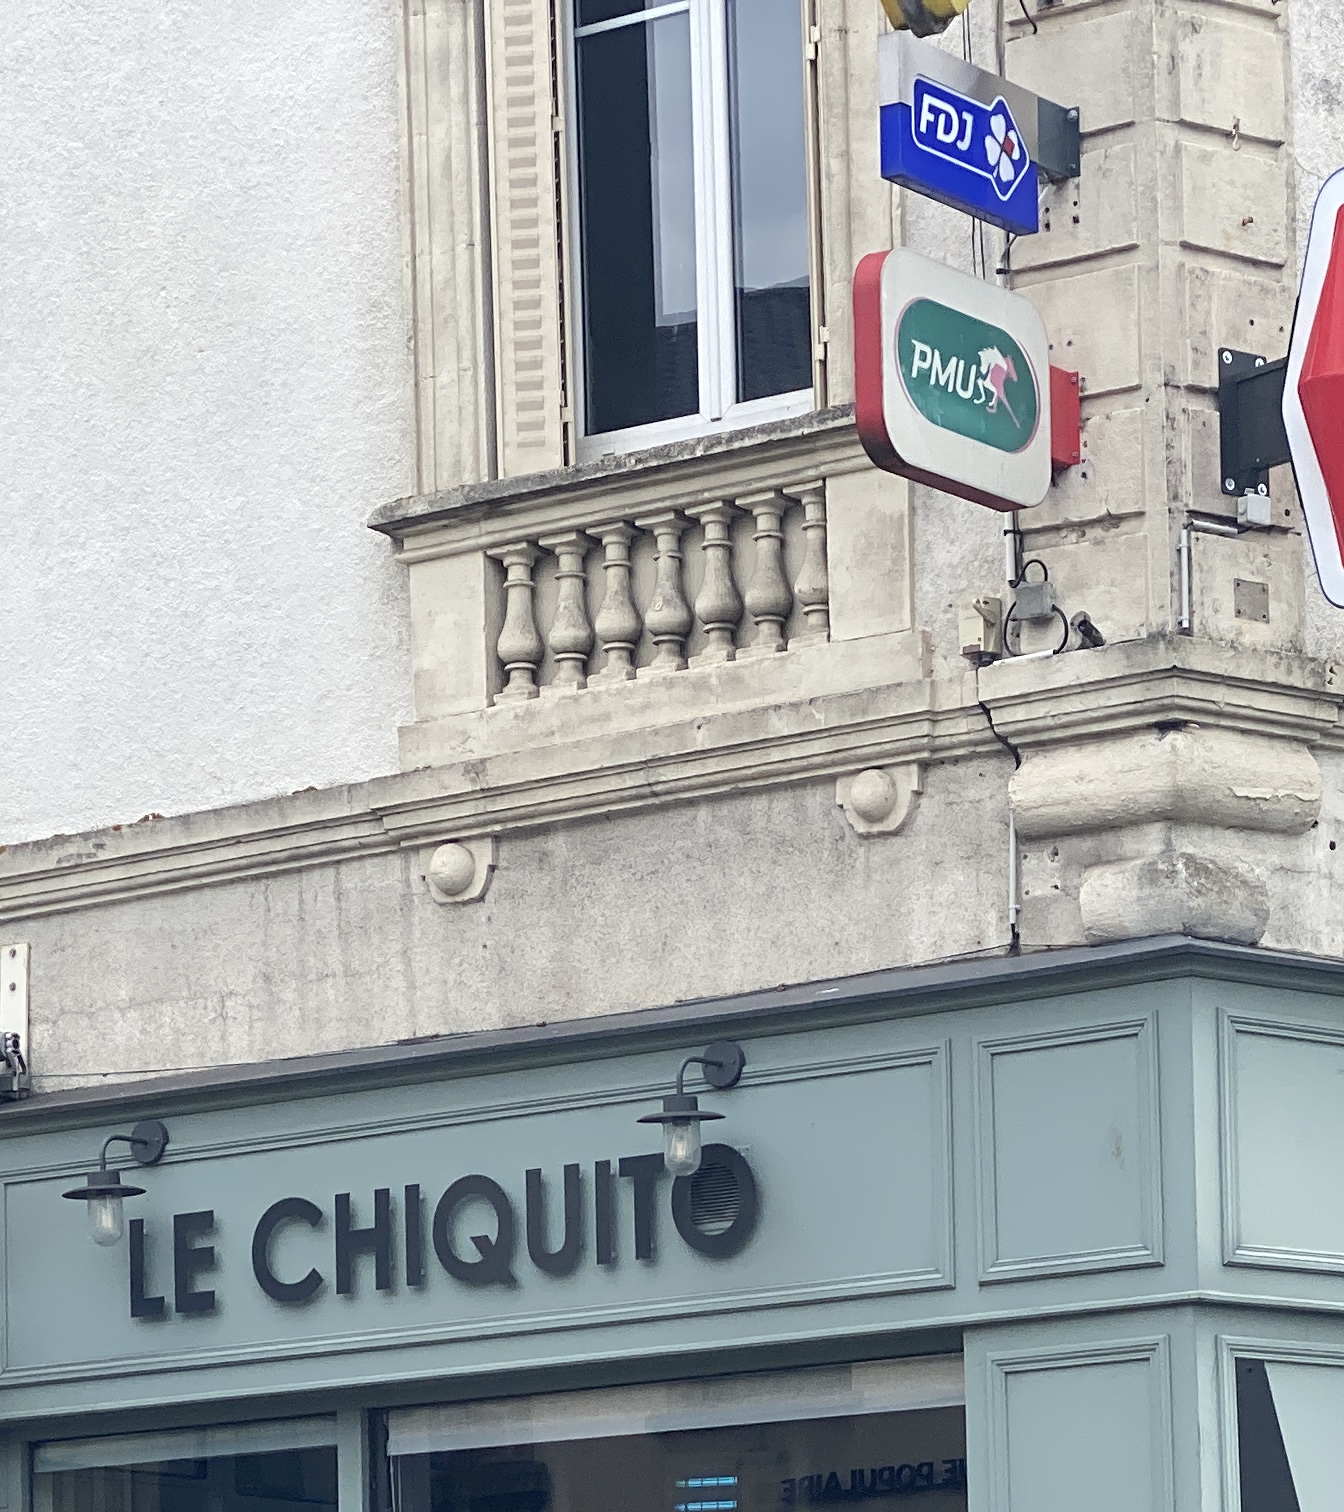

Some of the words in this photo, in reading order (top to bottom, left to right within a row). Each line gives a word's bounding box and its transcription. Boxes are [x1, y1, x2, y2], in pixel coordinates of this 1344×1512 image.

[919, 93, 973, 152] FDJ
[910, 339, 977, 401] PMU
[128, 1210, 216, 1318] LE
[252, 1142, 756, 1303] CHIQUITO
